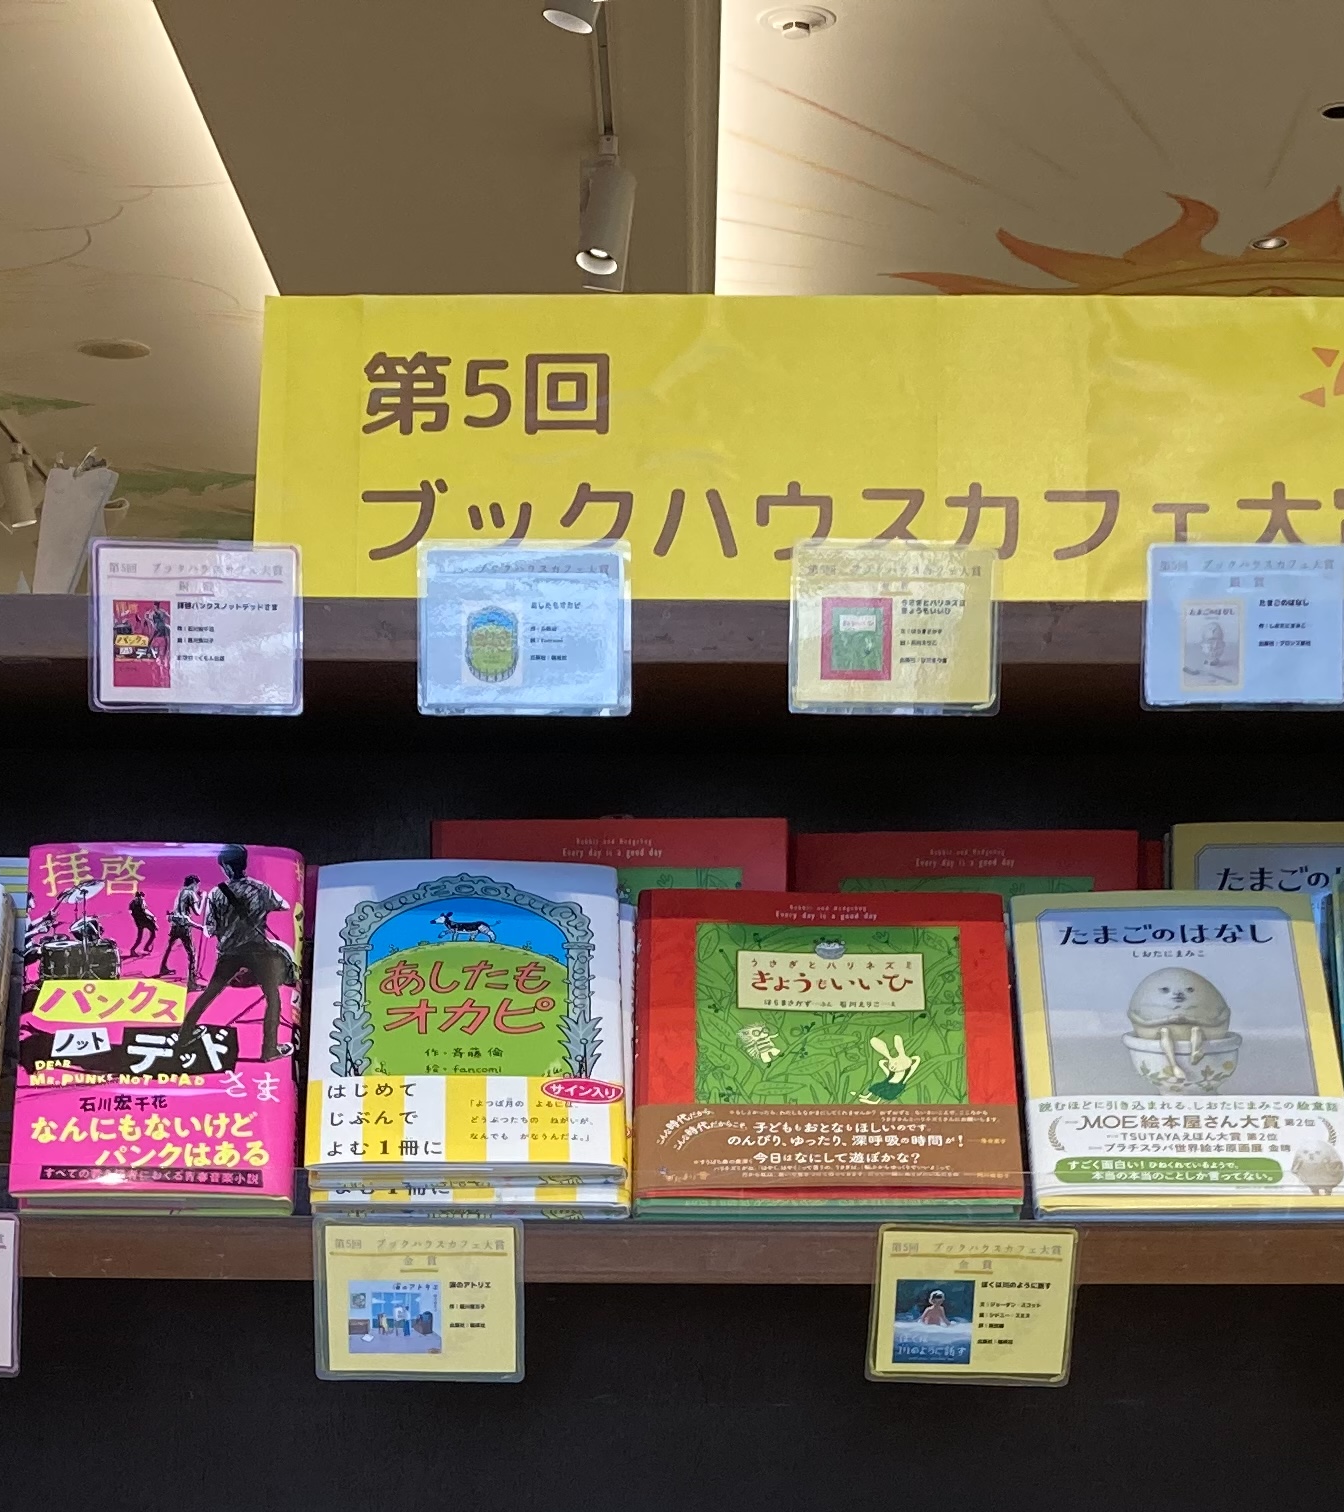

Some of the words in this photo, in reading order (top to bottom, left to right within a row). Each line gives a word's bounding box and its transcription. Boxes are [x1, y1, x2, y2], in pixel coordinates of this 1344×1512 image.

[360, 350, 611, 439] 第5回
[1258, 599, 1309, 607] たまごのはなし
[1059, 923, 1274, 946] たまごのはなし
[378, 959, 551, 997] あしたも
[38, 982, 178, 1022] パンクス
[383, 997, 555, 1035] オカピ
[327, 1083, 417, 1099] はじめて
[31, 1111, 258, 1143] なんにもないけど
[330, 1110, 419, 1125] じぶんで
[94, 1140, 270, 1168] パンクはある
[335, 1239, 362, 1250] 第5回
[377, 1239, 505, 1250] ブックハウスカフェ大賞
[934, 1243, 1062, 1255] ブックハウスカフェ大賞
